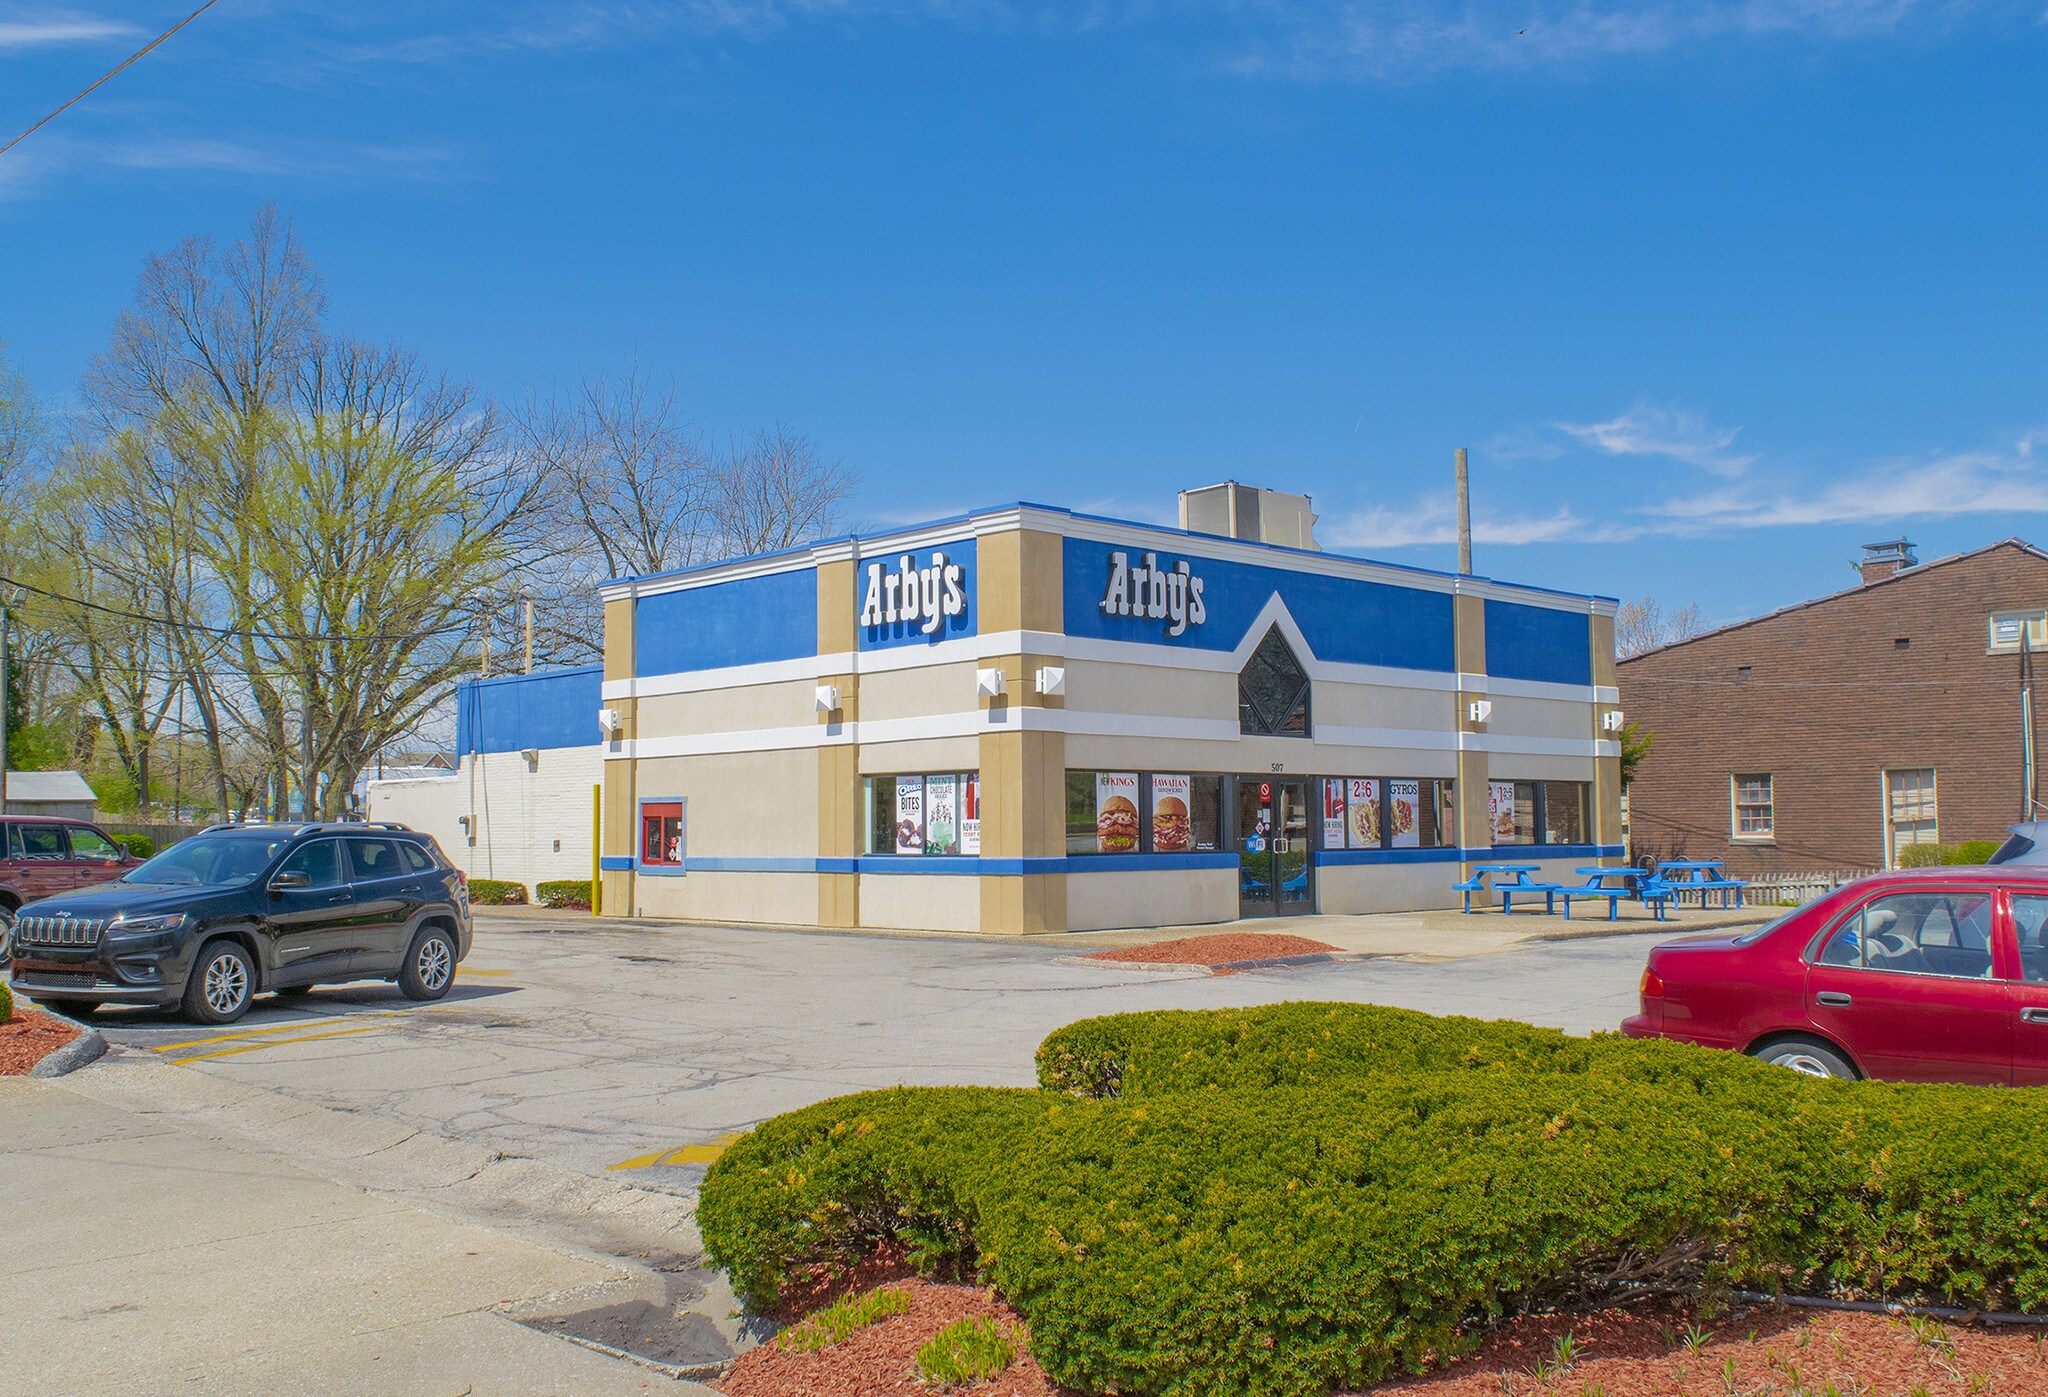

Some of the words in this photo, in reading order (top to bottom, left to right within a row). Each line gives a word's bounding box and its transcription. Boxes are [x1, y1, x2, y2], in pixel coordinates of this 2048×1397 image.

[861, 552, 962, 634] Arby's
[1105, 552, 1206, 636] Arby's
[1271, 763, 1284, 772] 507
[929, 776, 953, 785] MINT
[1110, 777, 1135, 787] KINGS
[1153, 778, 1188, 788] HAWAIIAN
[899, 784, 922, 796] OREO
[930, 785, 952, 794] CHOCOLATE
[1353, 780, 1361, 798] 2
[1390, 783, 1418, 795] GYROS
[901, 796, 920, 810] BITES
